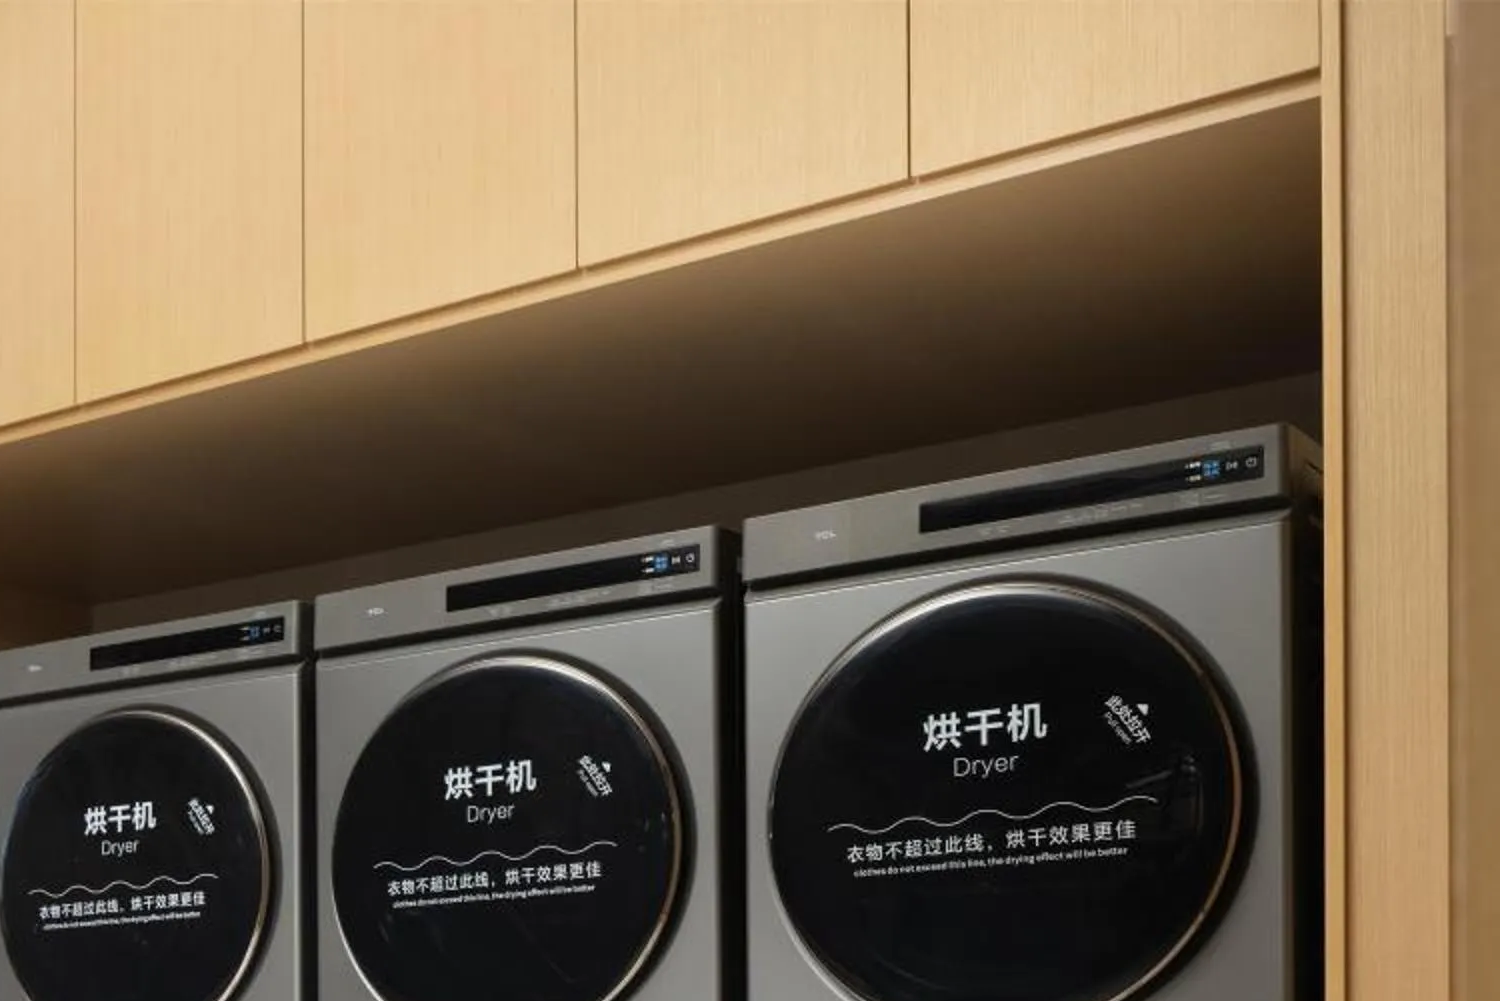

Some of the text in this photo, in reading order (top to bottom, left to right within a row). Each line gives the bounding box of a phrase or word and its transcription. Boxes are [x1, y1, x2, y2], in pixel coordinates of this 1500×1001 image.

[923, 703, 1047, 752] 烘干机
[444, 759, 537, 800] 烘干机
[953, 755, 1019, 779] Dryer
[84, 801, 157, 835] 烘干机
[467, 804, 515, 824] Dryer
[101, 840, 140, 858] Dryer
[847, 819, 1137, 864] 衣物不超过此线，烘干效果更佳
[387, 861, 602, 896] 衣物不超过此线，烘干效果更佳
